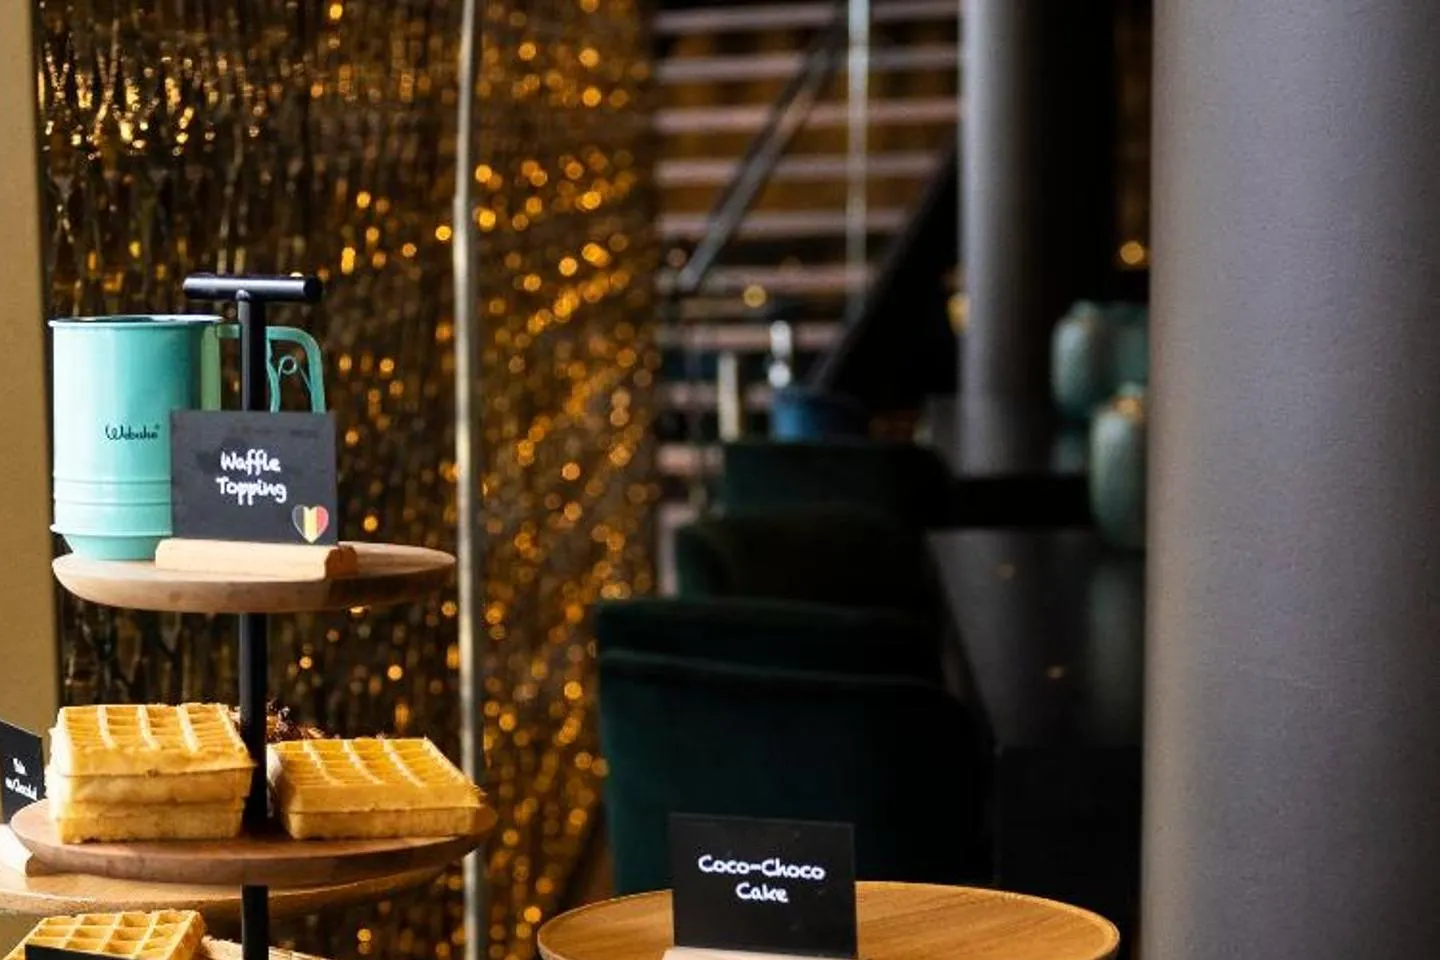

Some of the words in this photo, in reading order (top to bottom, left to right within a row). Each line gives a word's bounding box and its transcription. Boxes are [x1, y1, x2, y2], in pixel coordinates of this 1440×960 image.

[220, 448, 281, 476] Waffle
[215, 476, 287, 506] Topping
[698, 854, 826, 881] Coco-Choco
[735, 882, 789, 903] Cake
